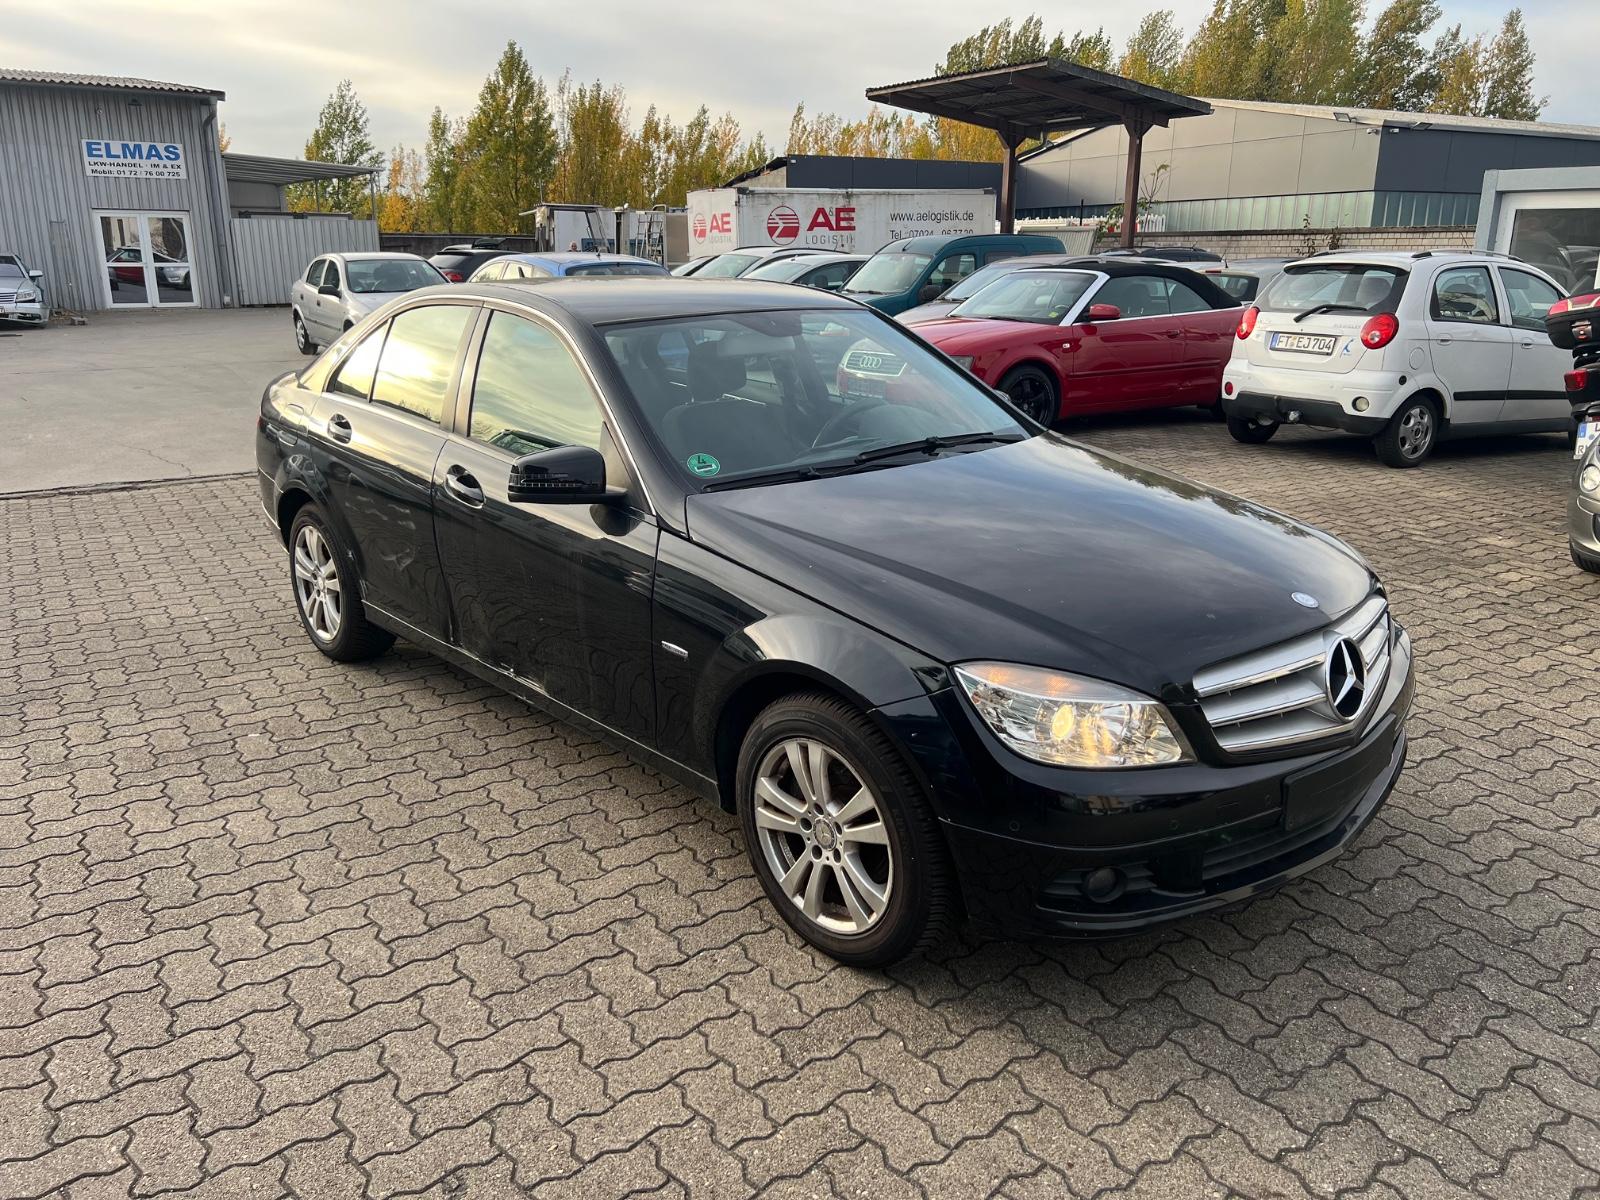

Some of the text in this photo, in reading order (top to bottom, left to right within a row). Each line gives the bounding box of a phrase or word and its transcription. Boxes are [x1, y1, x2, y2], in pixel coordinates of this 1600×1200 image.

[85, 141, 181, 161] ELMAS
[88, 160, 143, 169] LKW-HANDEL
[890, 210, 974, 223] www.aelogistik.de
[1277, 335, 1292, 347] FT
